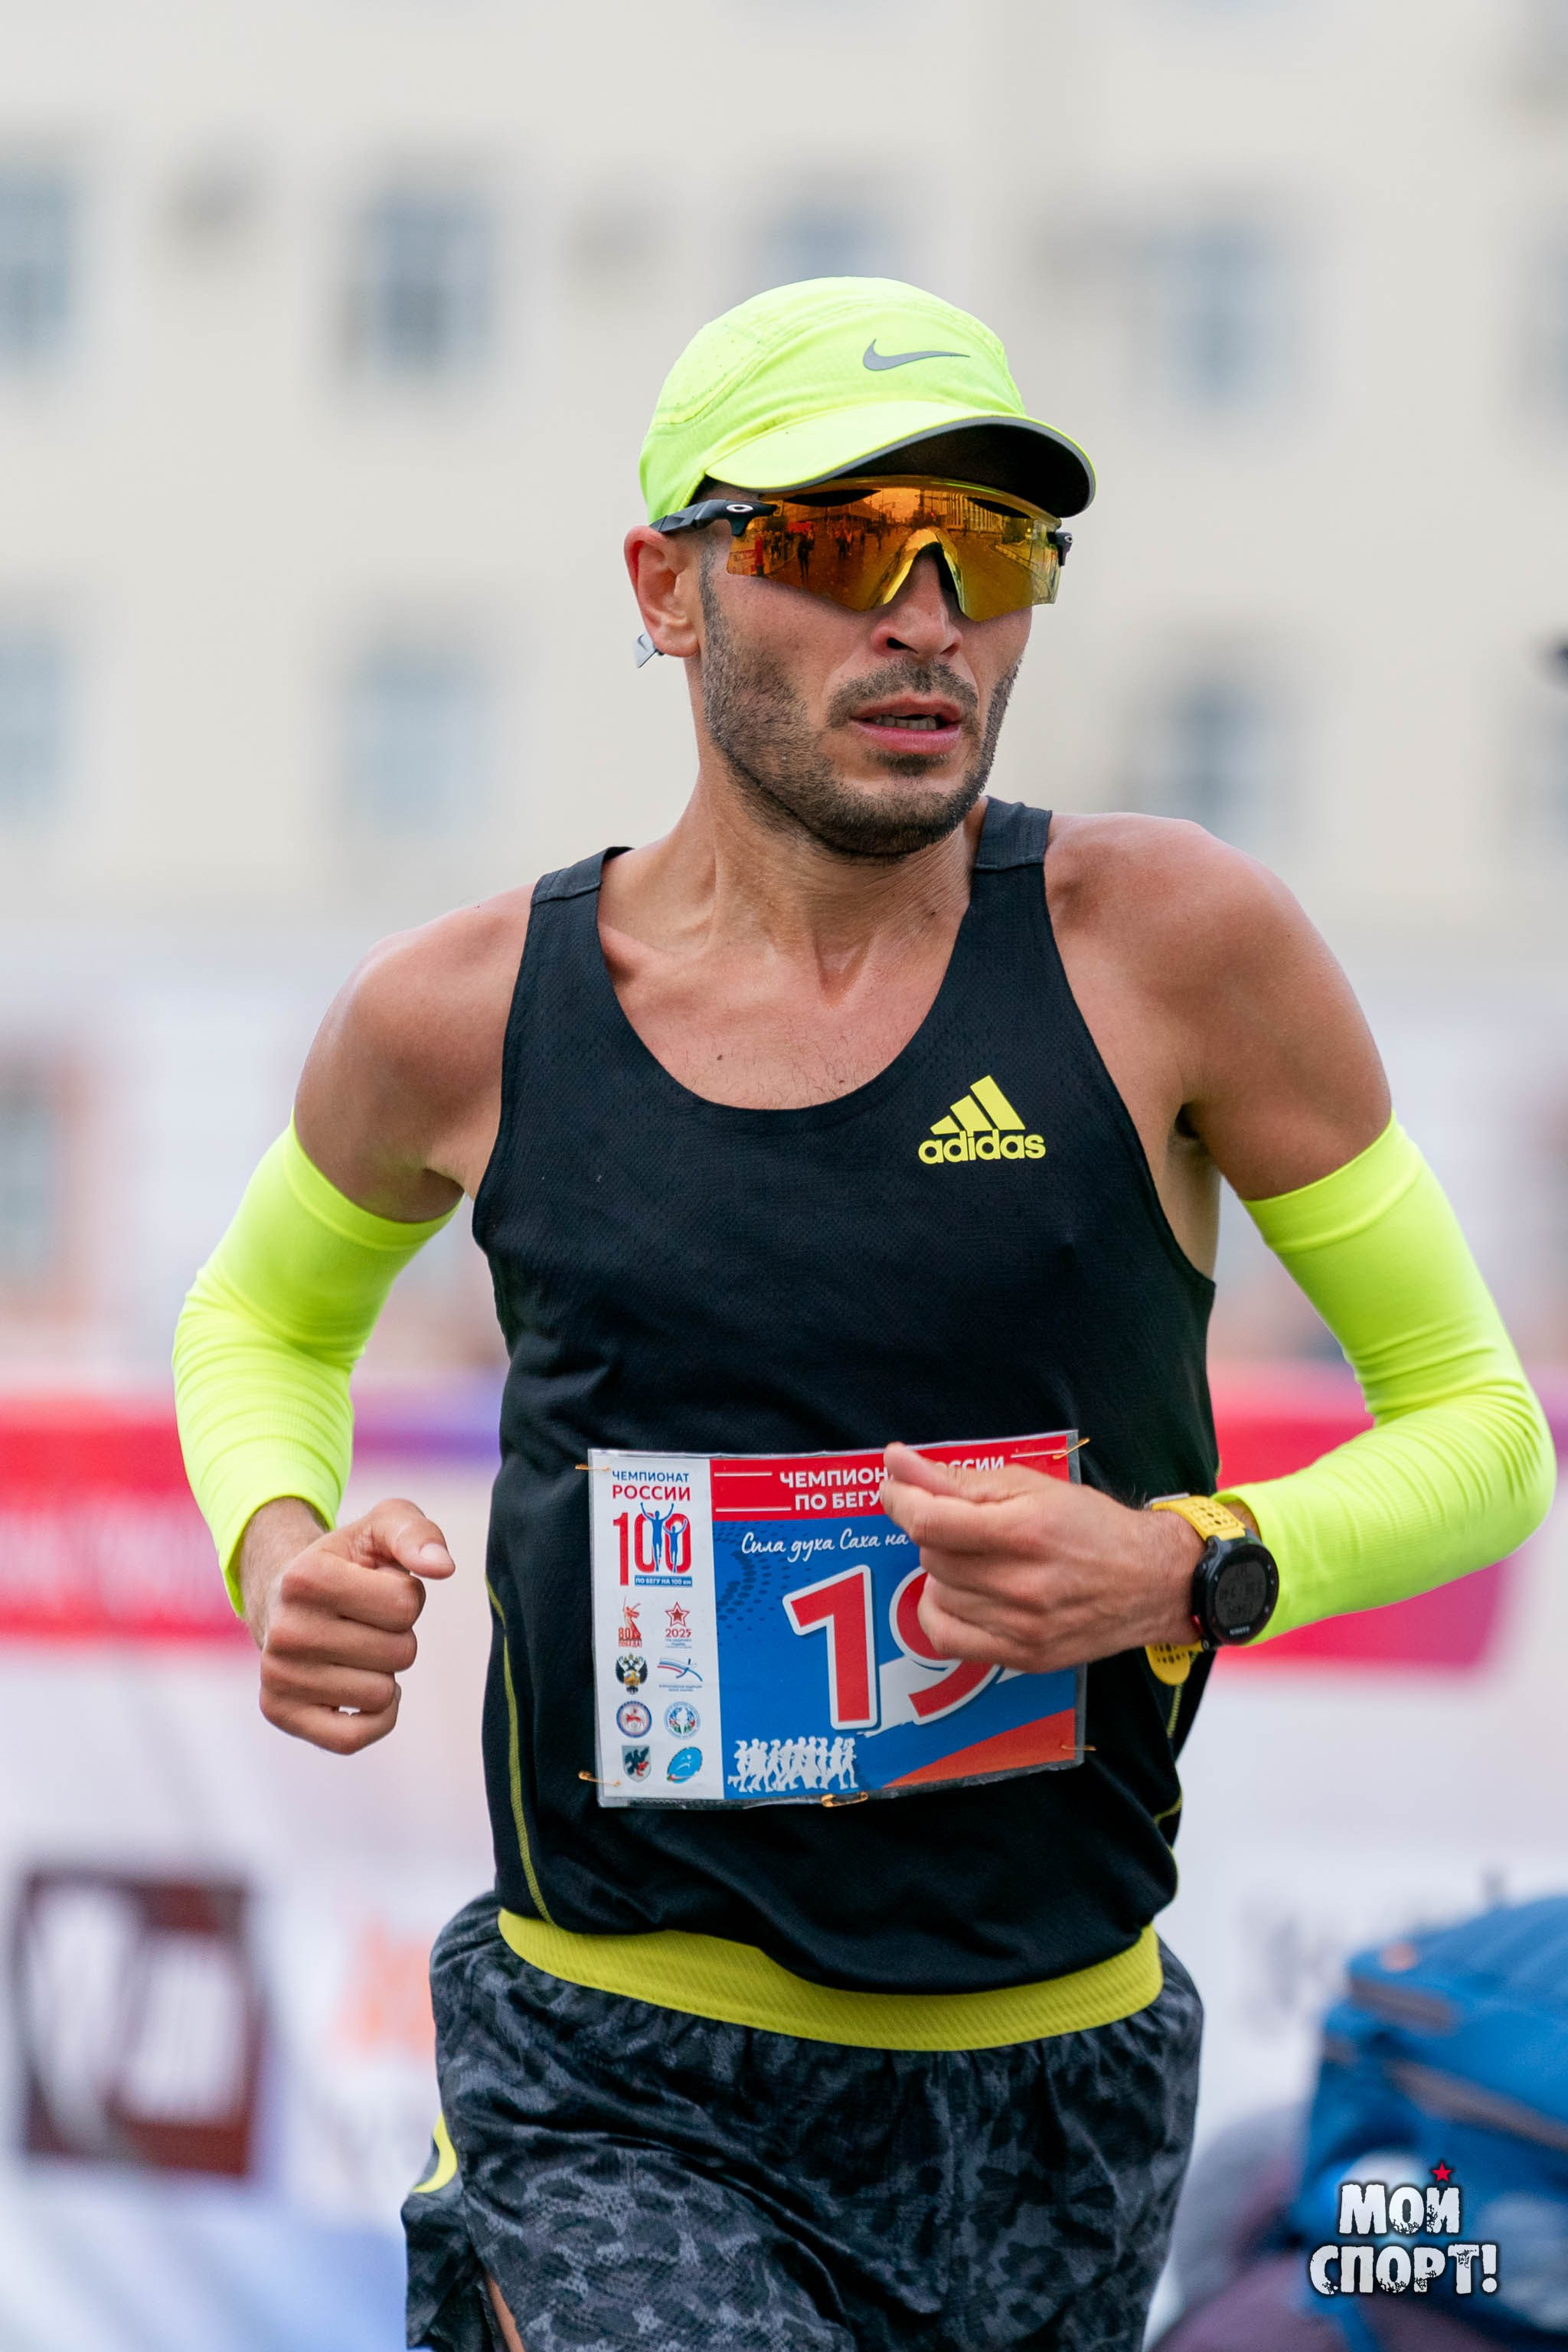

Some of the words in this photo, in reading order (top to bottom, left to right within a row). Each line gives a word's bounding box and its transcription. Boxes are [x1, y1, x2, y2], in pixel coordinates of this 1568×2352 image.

[918, 1129, 1047, 1165] adidas
[612, 1470, 690, 1483] ЧЕМПИОНАТ
[779, 1468, 893, 1488] ЧЕМПИОН
[612, 1485, 691, 1501] РОССИИ
[795, 1494, 827, 1511] ПО
[832, 1490, 880, 1509] БЕГУ
[612, 1512, 692, 1586] 100
[741, 1531, 786, 1554] Сила
[787, 1538, 835, 1563] духа
[839, 1528, 881, 1550] Саха
[782, 1564, 1003, 1730] 19
